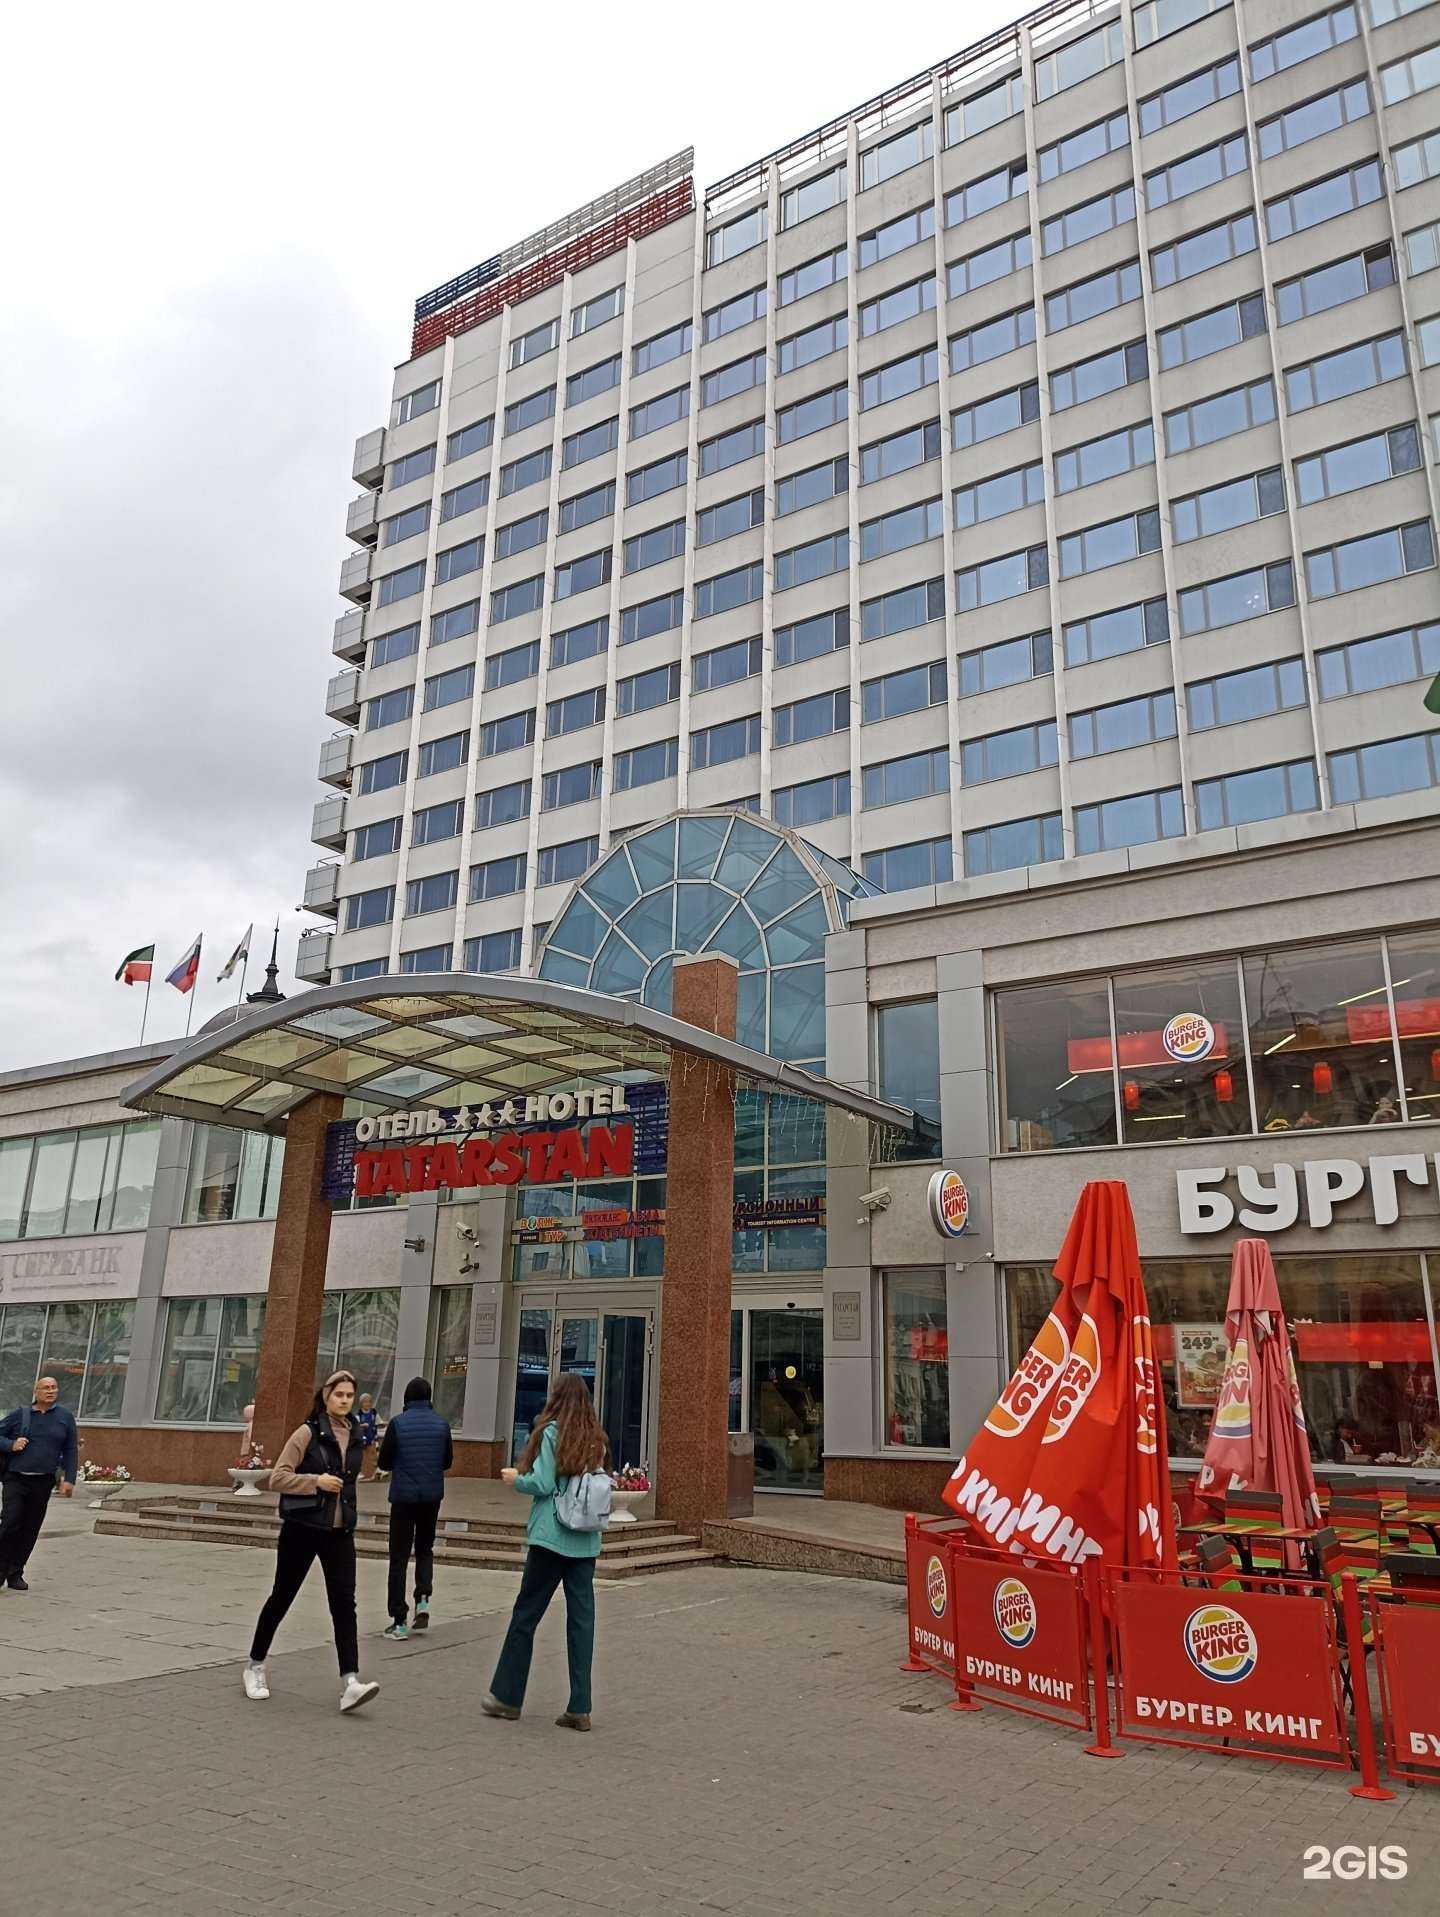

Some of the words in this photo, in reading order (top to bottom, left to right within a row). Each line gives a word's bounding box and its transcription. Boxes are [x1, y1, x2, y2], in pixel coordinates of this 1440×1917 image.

[1168, 1019, 1204, 1039] BURGER
[1170, 1027, 1206, 1050] KING
[356, 1109, 446, 1143] ОТЕЛЬ
[525, 1087, 630, 1123] HOTEL
[352, 1124, 634, 1197] TATARSTAN
[943, 1185, 966, 1203] BURGER
[1176, 1152, 1440, 1235] БУРГ
[944, 1197, 967, 1218] KING
[928, 1569, 944, 1583] BURGER
[929, 1580, 945, 1600] KING
[998, 1593, 1030, 1611] BURGER
[1000, 1605, 1032, 1628] KING
[914, 1626, 941, 1652] БУРГЕР
[1191, 1620, 1246, 1644] BURGER
[1195, 1634, 1250, 1663] KING
[966, 1655, 1022, 1686] БУРГЕР
[1028, 1672, 1074, 1702] КИНГ
[1136, 1696, 1233, 1728] БУРГЕР
[1245, 1710, 1322, 1740] КИНГ
